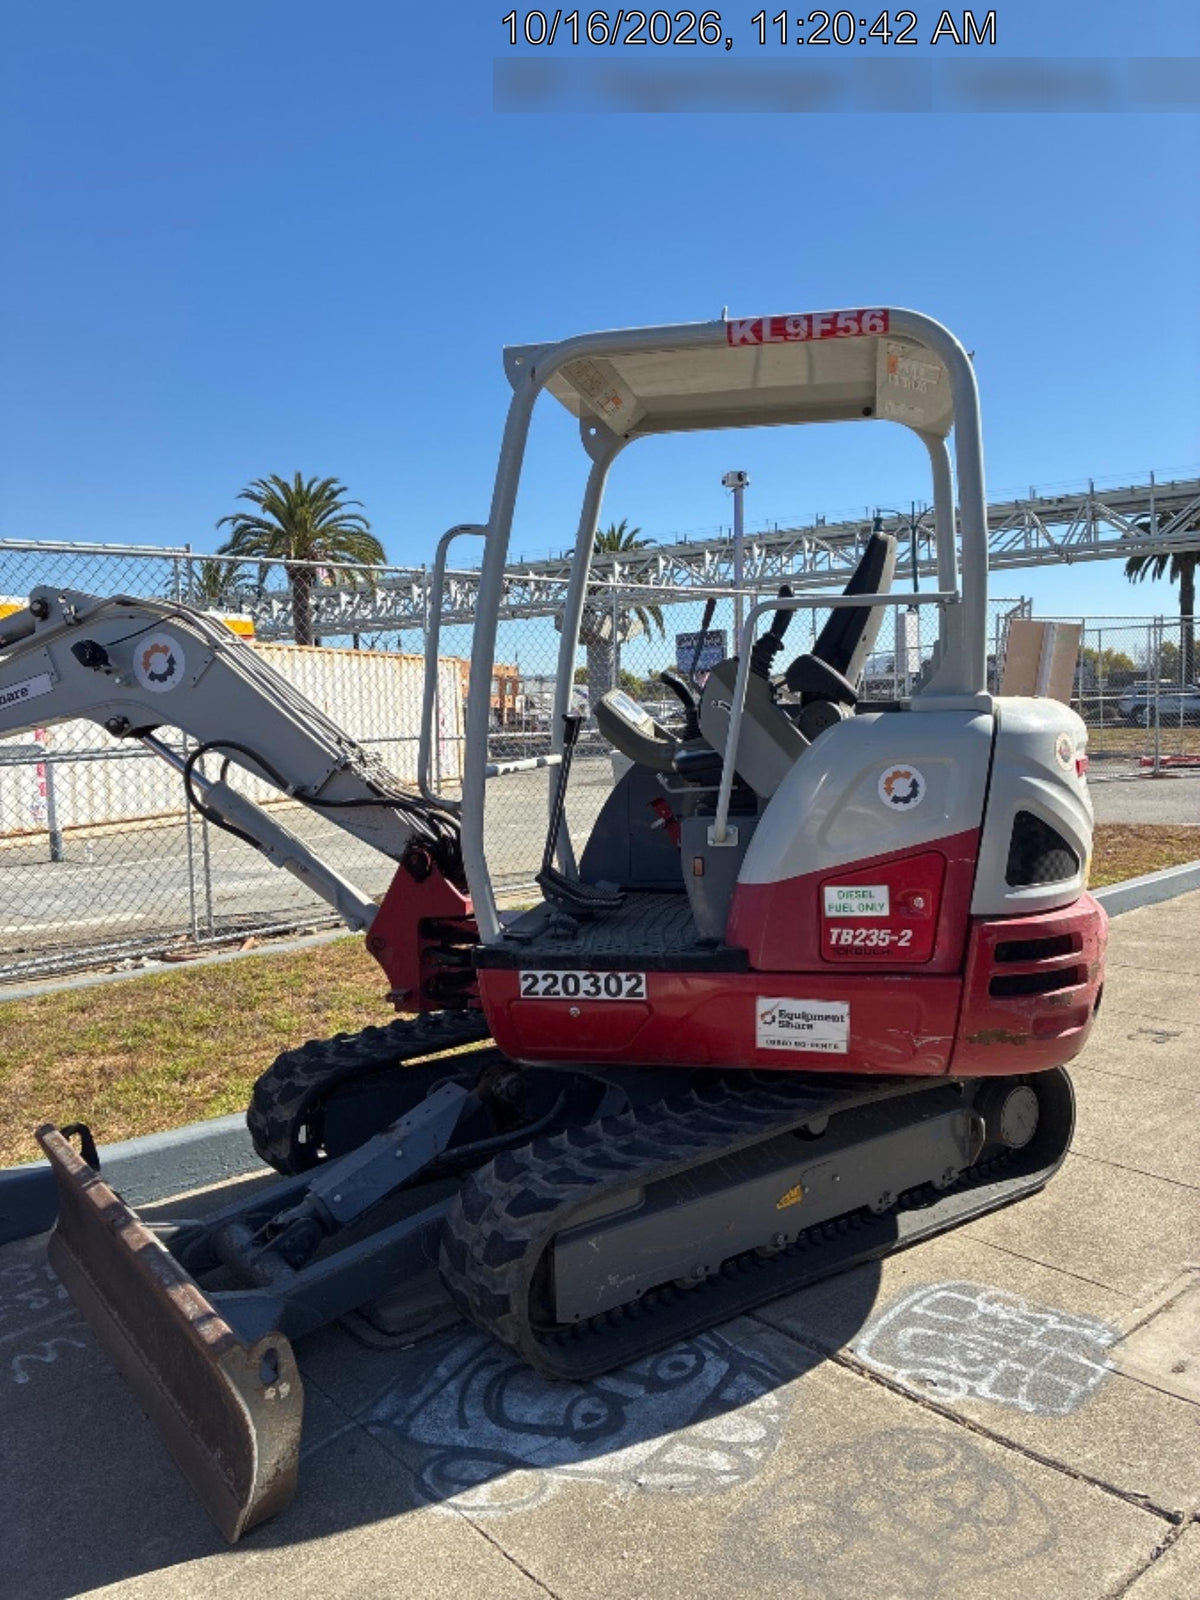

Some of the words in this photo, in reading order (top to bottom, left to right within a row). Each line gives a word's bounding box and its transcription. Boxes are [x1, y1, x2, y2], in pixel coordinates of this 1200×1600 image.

[730, 310, 887, 345] KL9F56
[837, 890, 875, 900] DIESEL
[828, 903, 855, 913] FUEL
[858, 903, 885, 912] ONLY
[829, 928, 913, 947] TB235-2
[521, 973, 645, 998] 220302
[778, 1009, 845, 1023] Equipment
[778, 1020, 813, 1030] Share
